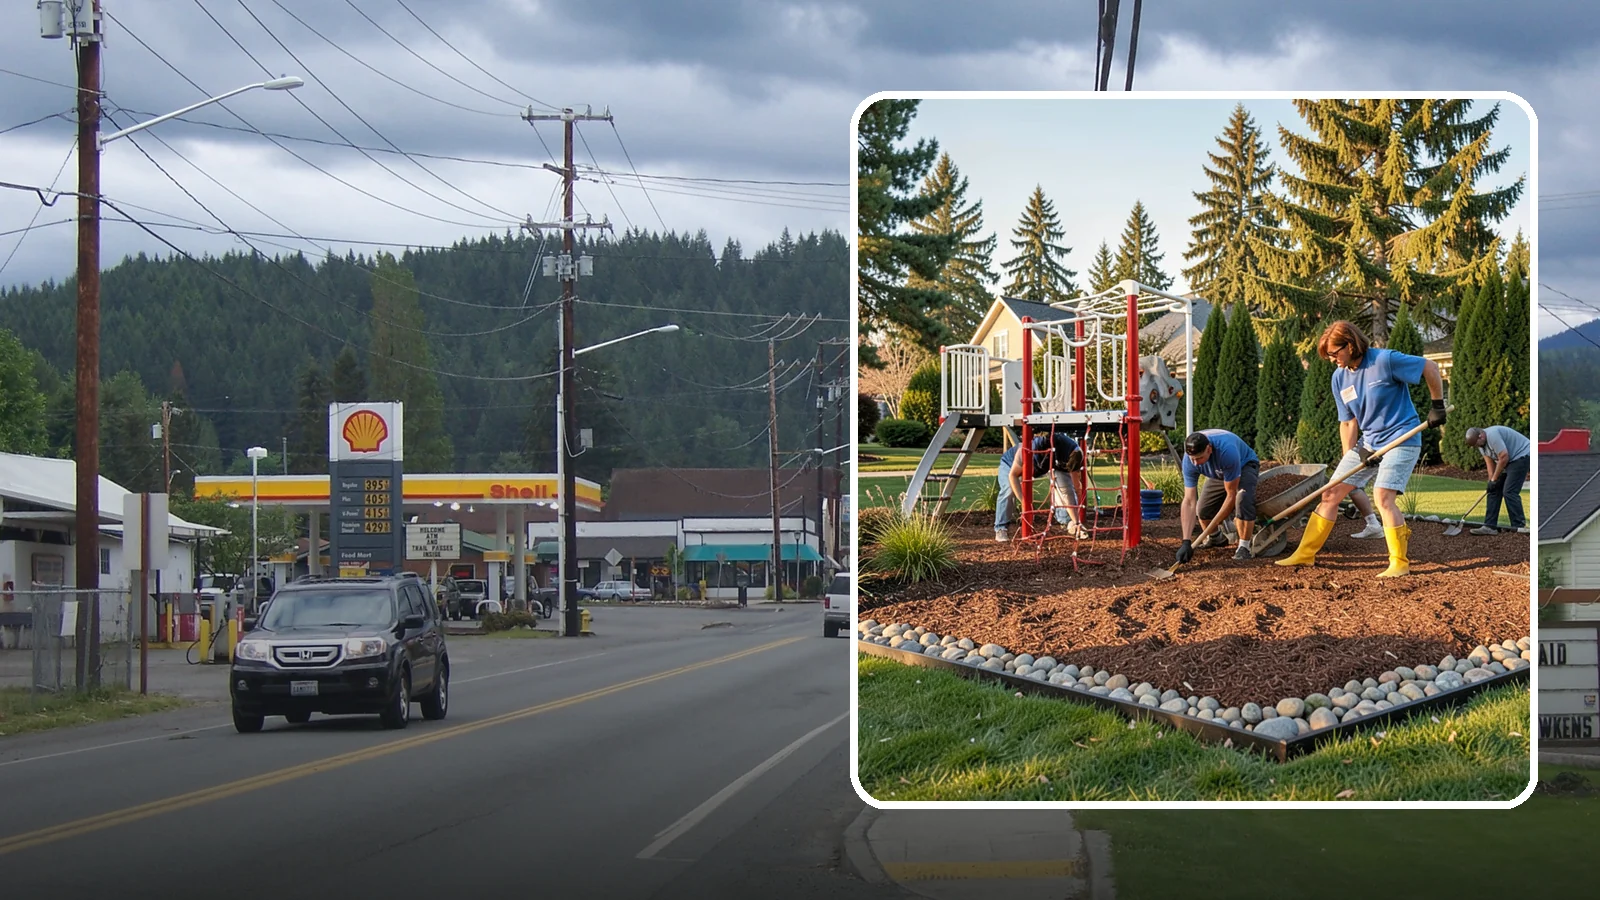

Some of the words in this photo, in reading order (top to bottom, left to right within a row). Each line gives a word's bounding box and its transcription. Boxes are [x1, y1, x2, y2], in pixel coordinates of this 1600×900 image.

[366, 479, 383, 490] 395
[490, 484, 547, 499] Shell
[366, 494, 383, 504] 405
[366, 508, 383, 518] 415
[366, 522, 383, 532] 429
